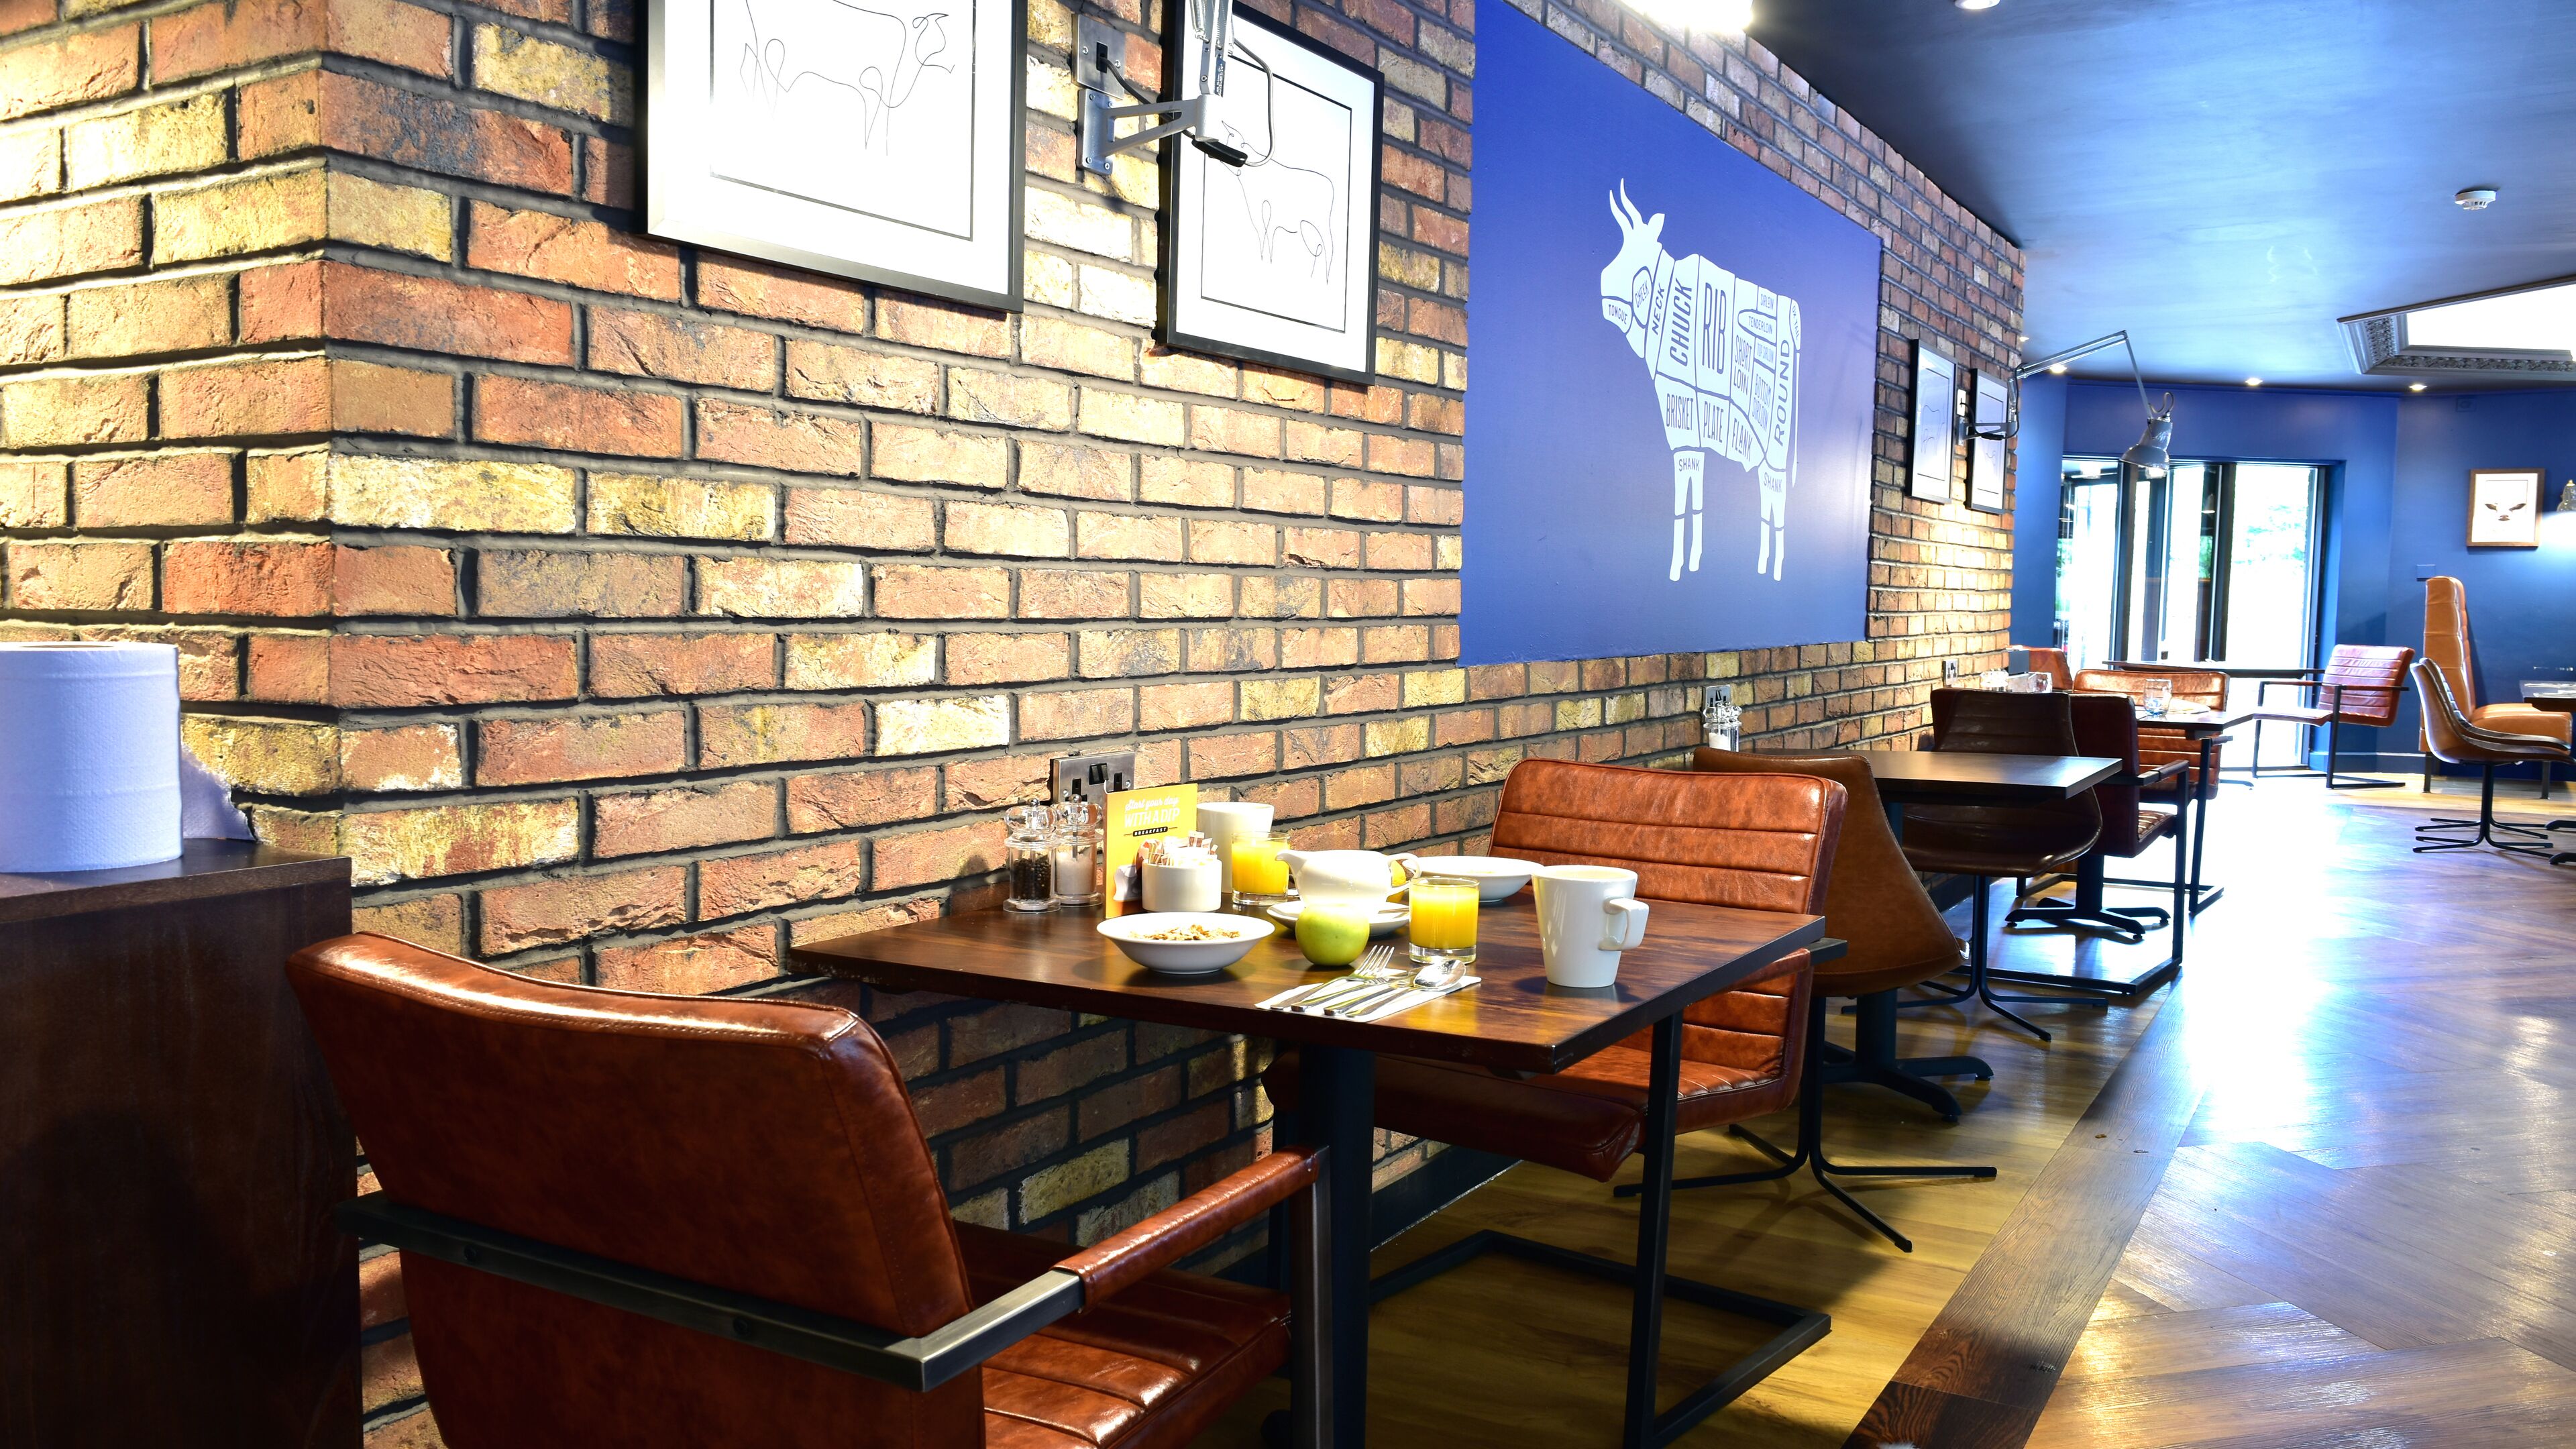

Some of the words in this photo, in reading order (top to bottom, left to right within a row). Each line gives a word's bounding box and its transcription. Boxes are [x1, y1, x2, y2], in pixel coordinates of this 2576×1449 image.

[1635, 280, 1649, 308] CHEEK
[1652, 282, 1664, 335] NECK
[1609, 304, 1627, 325] TONGUE
[1670, 278, 1692, 367] CHUCK
[1702, 282, 1726, 374] RIB
[1748, 315, 1772, 334] TENDERLOIN
[1792, 305, 1796, 319] OX
[1735, 334, 1752, 372] SHORT
[1733, 365, 1749, 396] LOIN
[1755, 373, 1771, 408] BOTTOM
[1774, 339, 1789, 447] ROUND
[1666, 393, 1693, 431] BRISKET
[1703, 400, 1724, 443] PLATE
[1752, 397, 1769, 432] SIRLOIN
[1731, 417, 1752, 462] FLANK
[1678, 458, 1700, 472] SHANK
[1764, 472, 1782, 493] SHANK
[1124, 810, 1152, 828] WITH
[1152, 810, 1159, 824] A
[1161, 808, 1180, 822] DIP
[1126, 799, 1145, 812] Start
[1146, 798, 1163, 810] your
[1165, 796, 1179, 807] day
[1134, 827, 1167, 836] BREAKFAST
